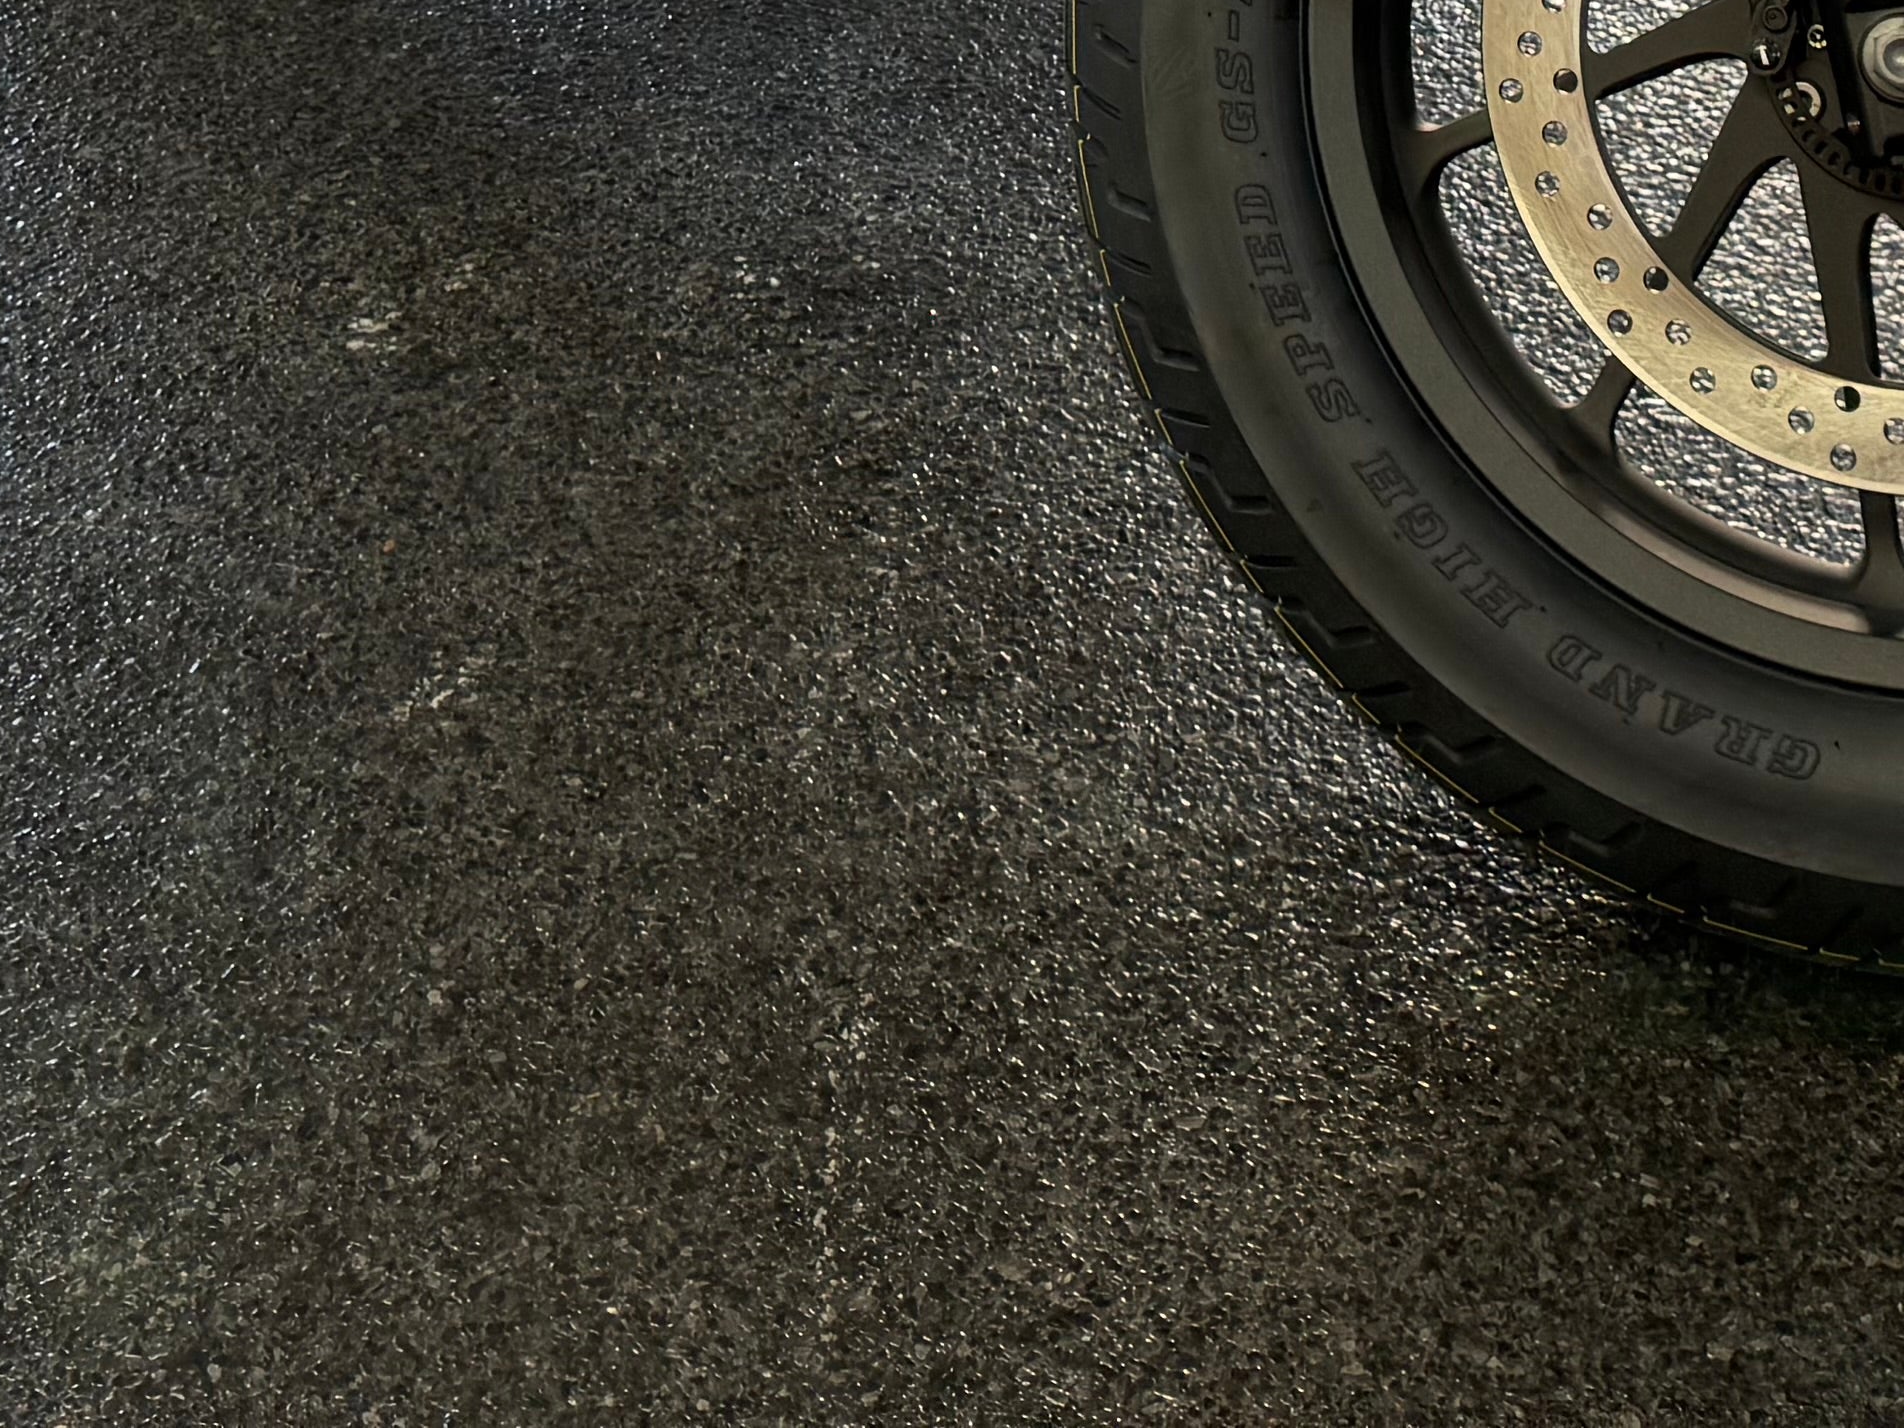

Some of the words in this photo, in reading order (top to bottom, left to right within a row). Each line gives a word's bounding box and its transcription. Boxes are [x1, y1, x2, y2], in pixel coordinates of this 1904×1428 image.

[1233, 182, 1363, 425] SPEED
[1350, 447, 1535, 631] HIGH
[1547, 634, 1821, 781] GRAND
